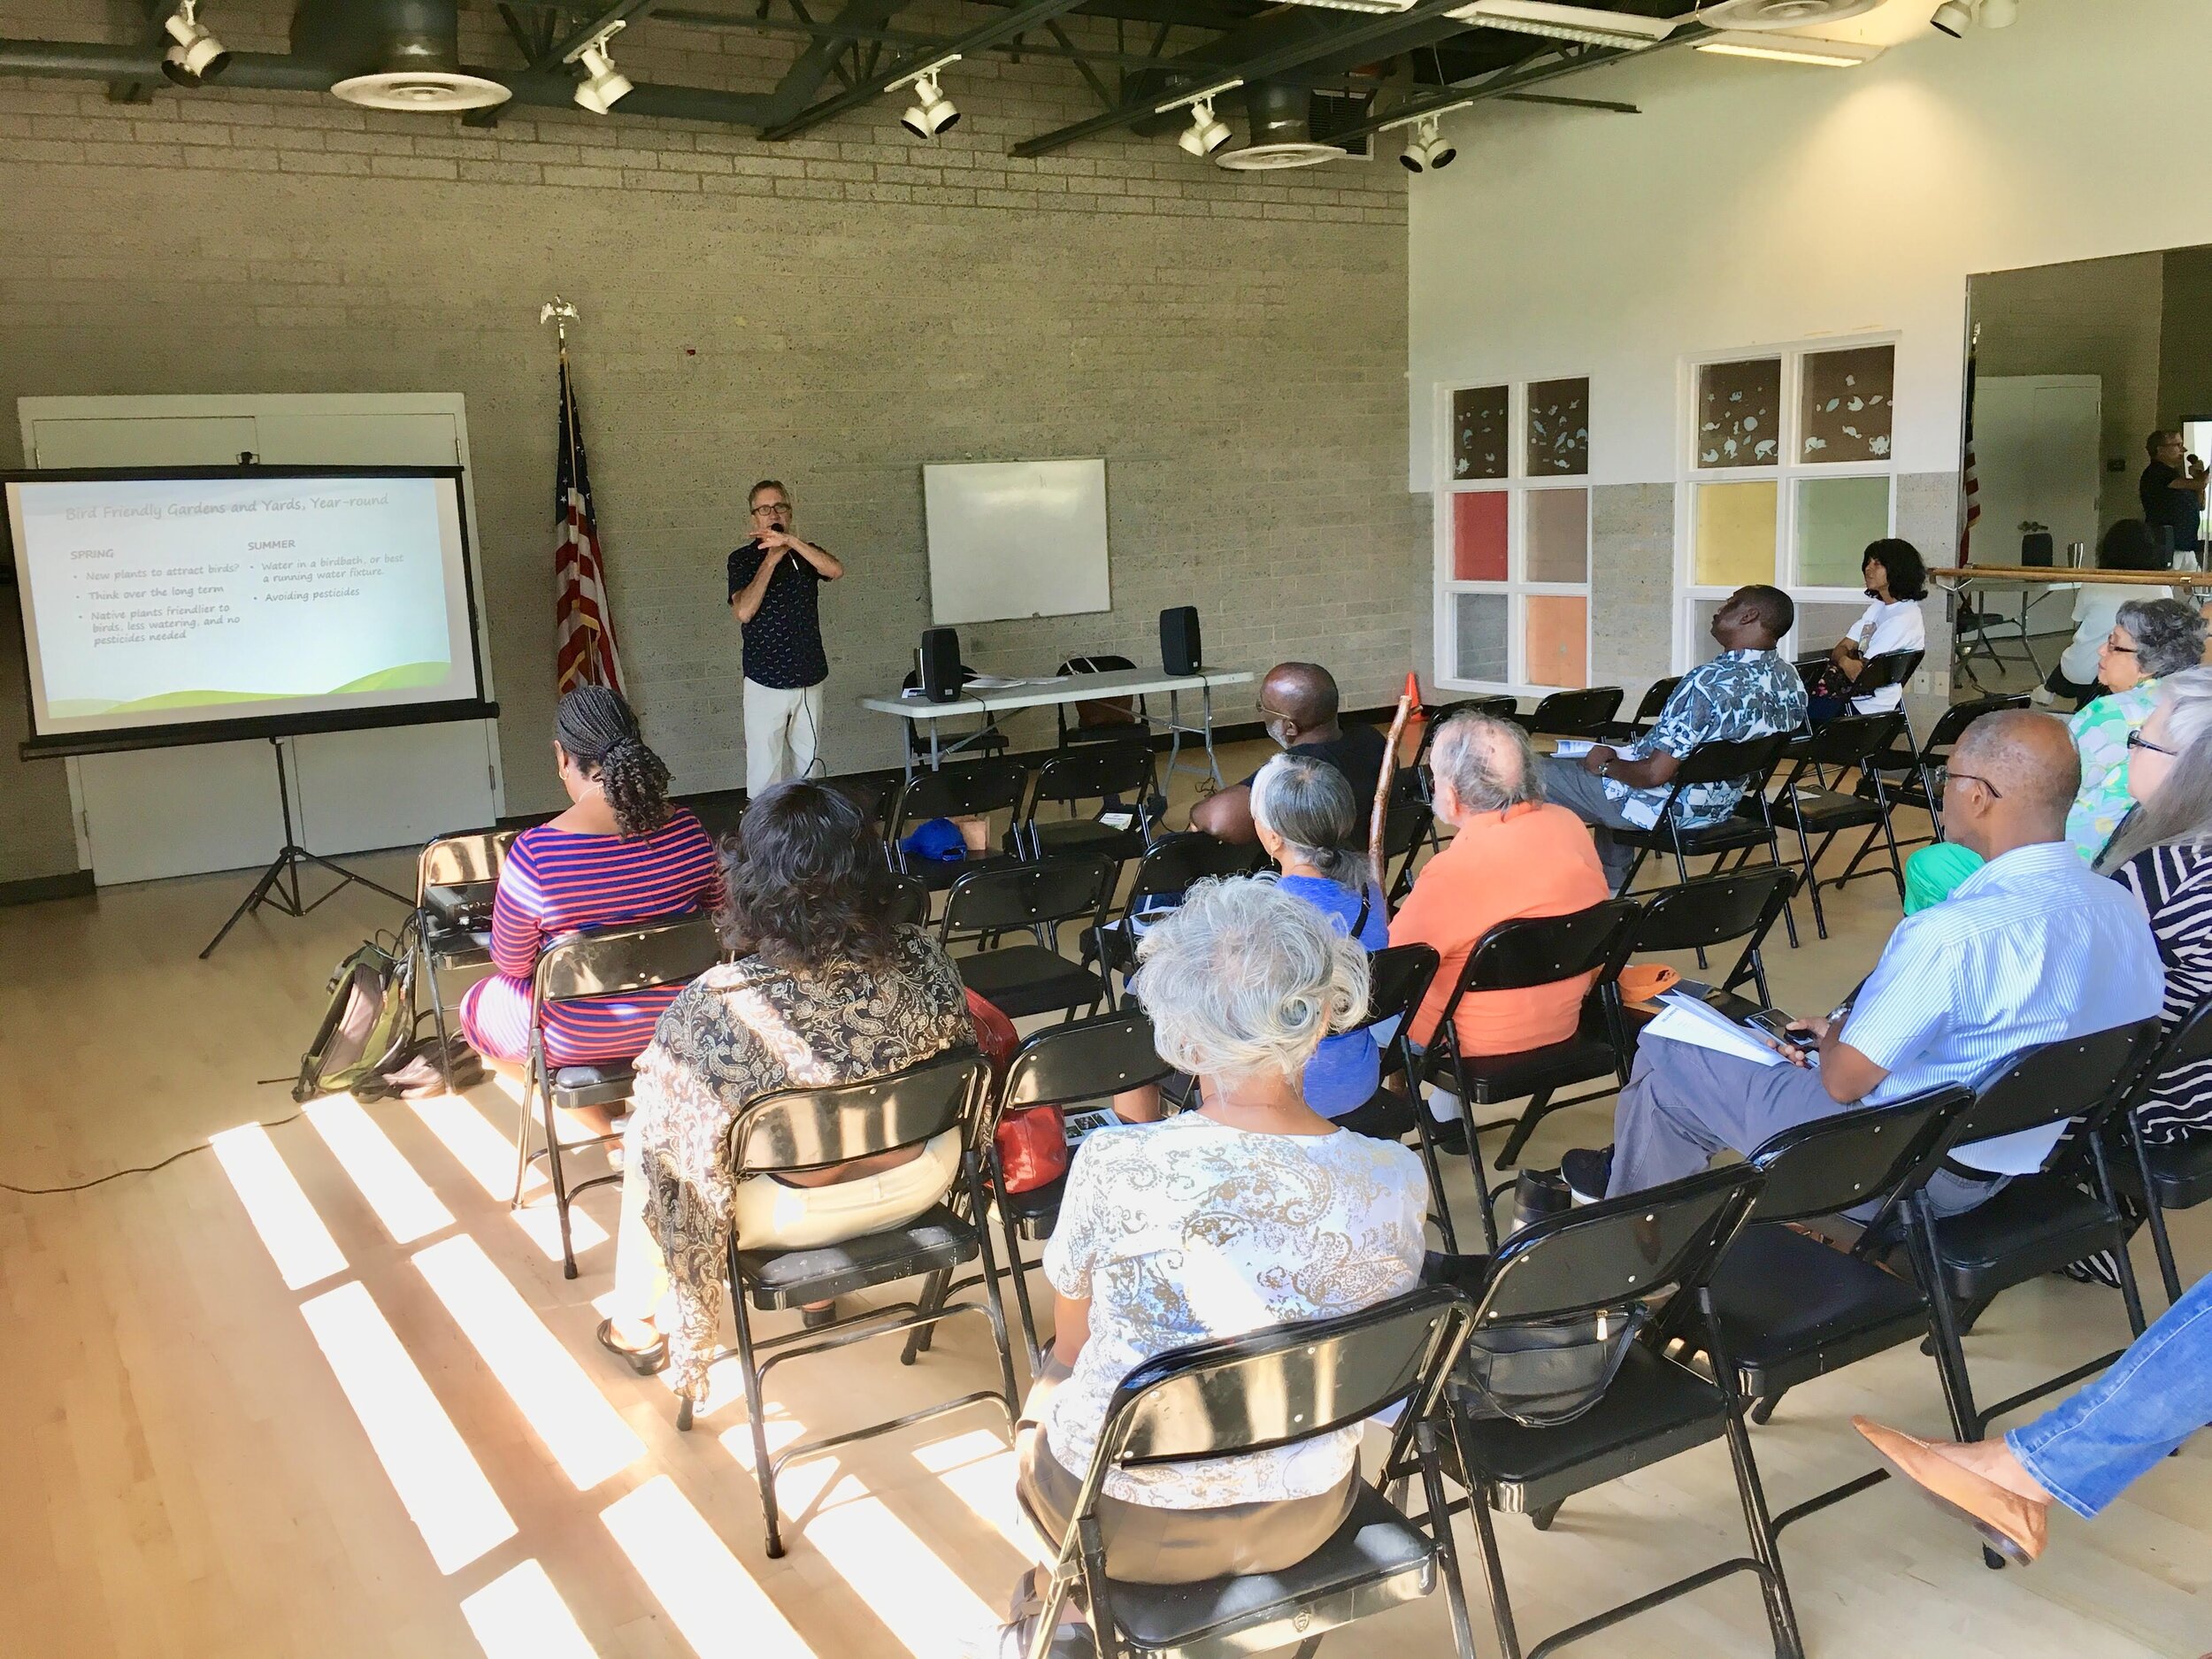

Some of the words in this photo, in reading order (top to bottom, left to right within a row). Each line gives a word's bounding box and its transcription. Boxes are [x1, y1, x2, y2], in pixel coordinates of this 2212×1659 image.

[65, 506, 96, 520] Bird
[103, 503, 162, 519] Friendly
[167, 502, 227, 516] Gardens
[231, 501, 257, 512] and
[261, 497, 306, 511] Yards,
[311, 493, 388, 509] Year-round
[248, 540, 296, 550] SUMMER
[71, 549, 114, 560] SPRING
[261, 561, 293, 571] Water
[296, 559, 307, 568] in
[384, 553, 404, 563] best
[86, 572, 111, 580] New
[114, 569, 148, 581] plants
[166, 565, 204, 576] attract
[208, 563, 240, 574] birds?
[273, 572, 313, 582] running
[317, 570, 347, 580] water
[88, 590, 119, 601] Think
[150, 588, 167, 597] the
[172, 586, 194, 597] long
[265, 591, 309, 602] Avoiding
[312, 588, 360, 601] pesticides
[91, 611, 126, 620] Native
[130, 608, 163, 622] plants
[166, 604, 215, 616] friendlier
[127, 621, 145, 631] less
[204, 615, 224, 625] and
[227, 616, 241, 625] no
[94, 633, 145, 648] pesticides
[149, 630, 187, 641] needed
